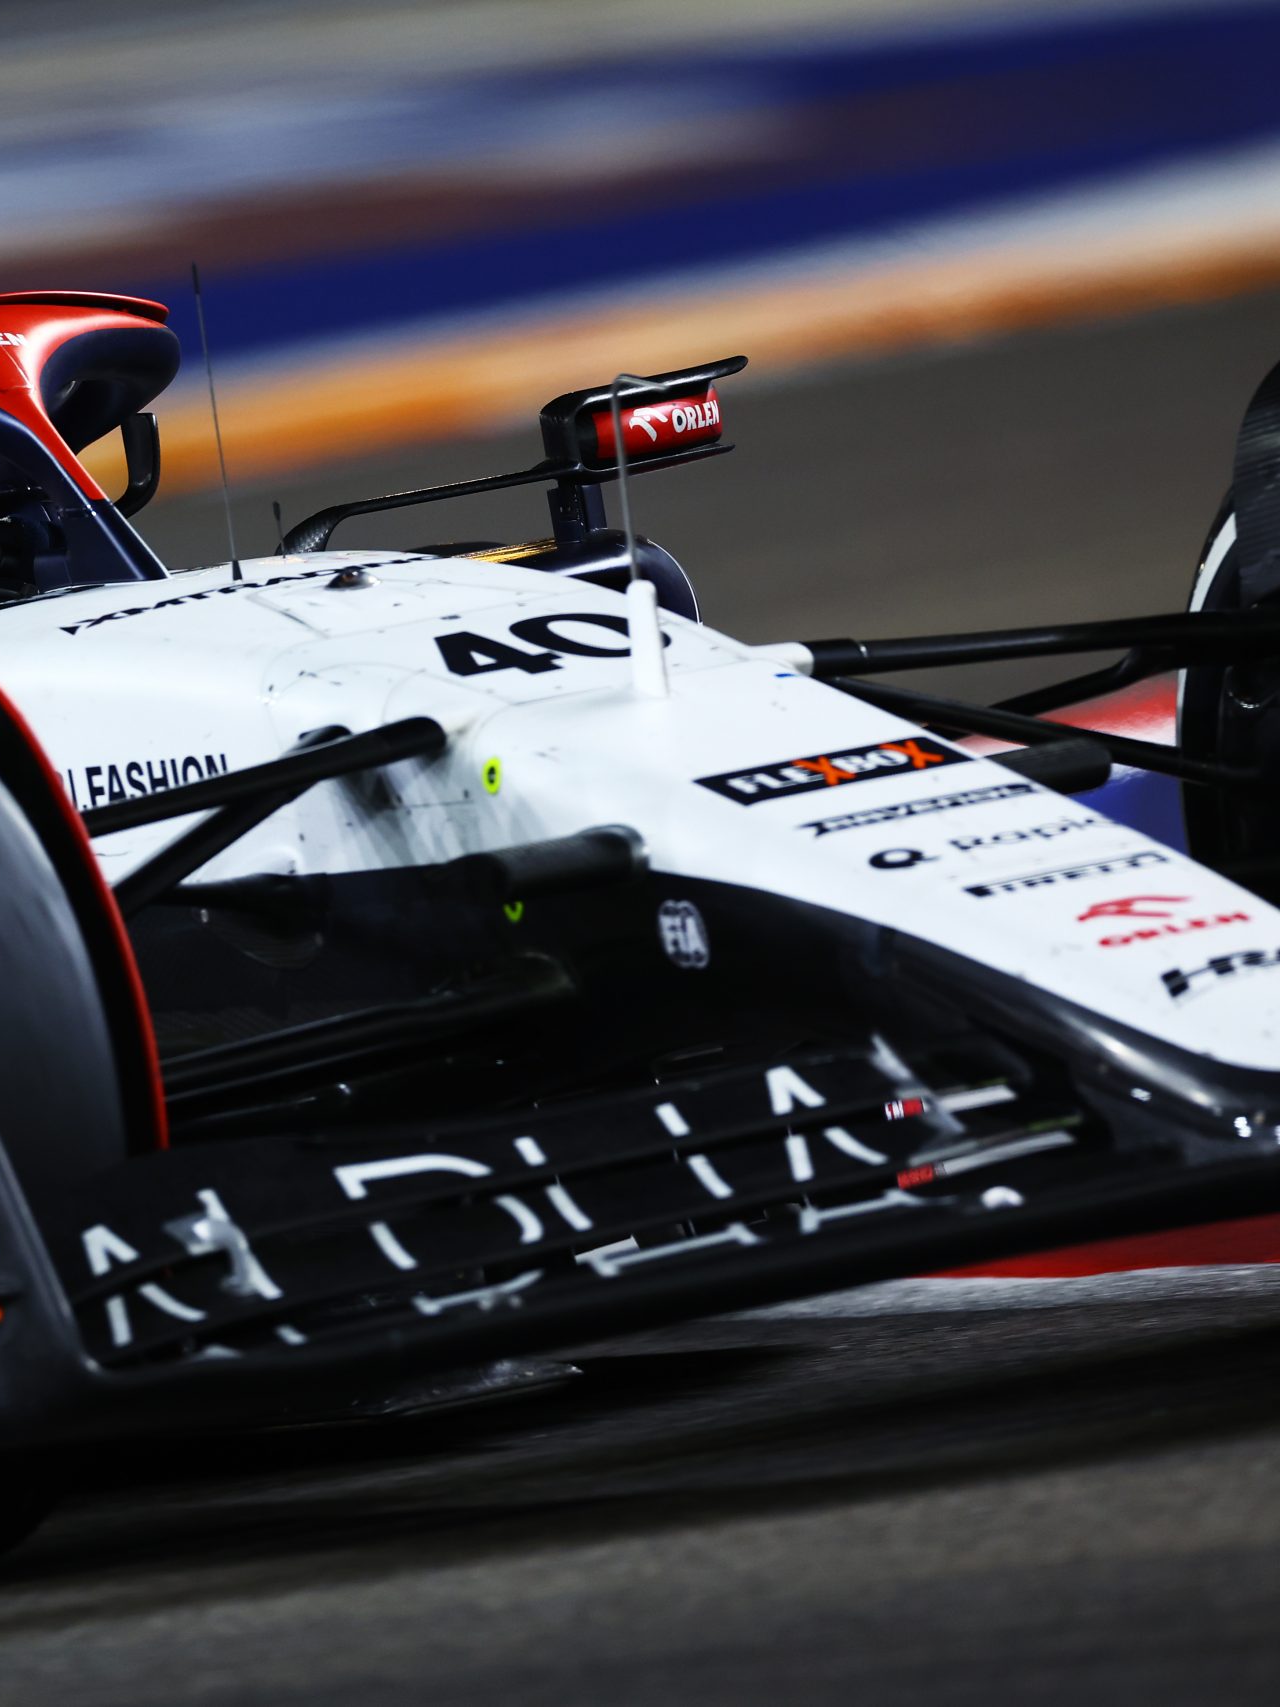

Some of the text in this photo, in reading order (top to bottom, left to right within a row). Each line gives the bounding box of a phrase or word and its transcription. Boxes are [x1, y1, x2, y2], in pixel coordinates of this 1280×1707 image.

[672, 400, 720, 433] ORLEN
[434, 613, 672, 678] 40
[726, 740, 944, 794] FLEXBOX
